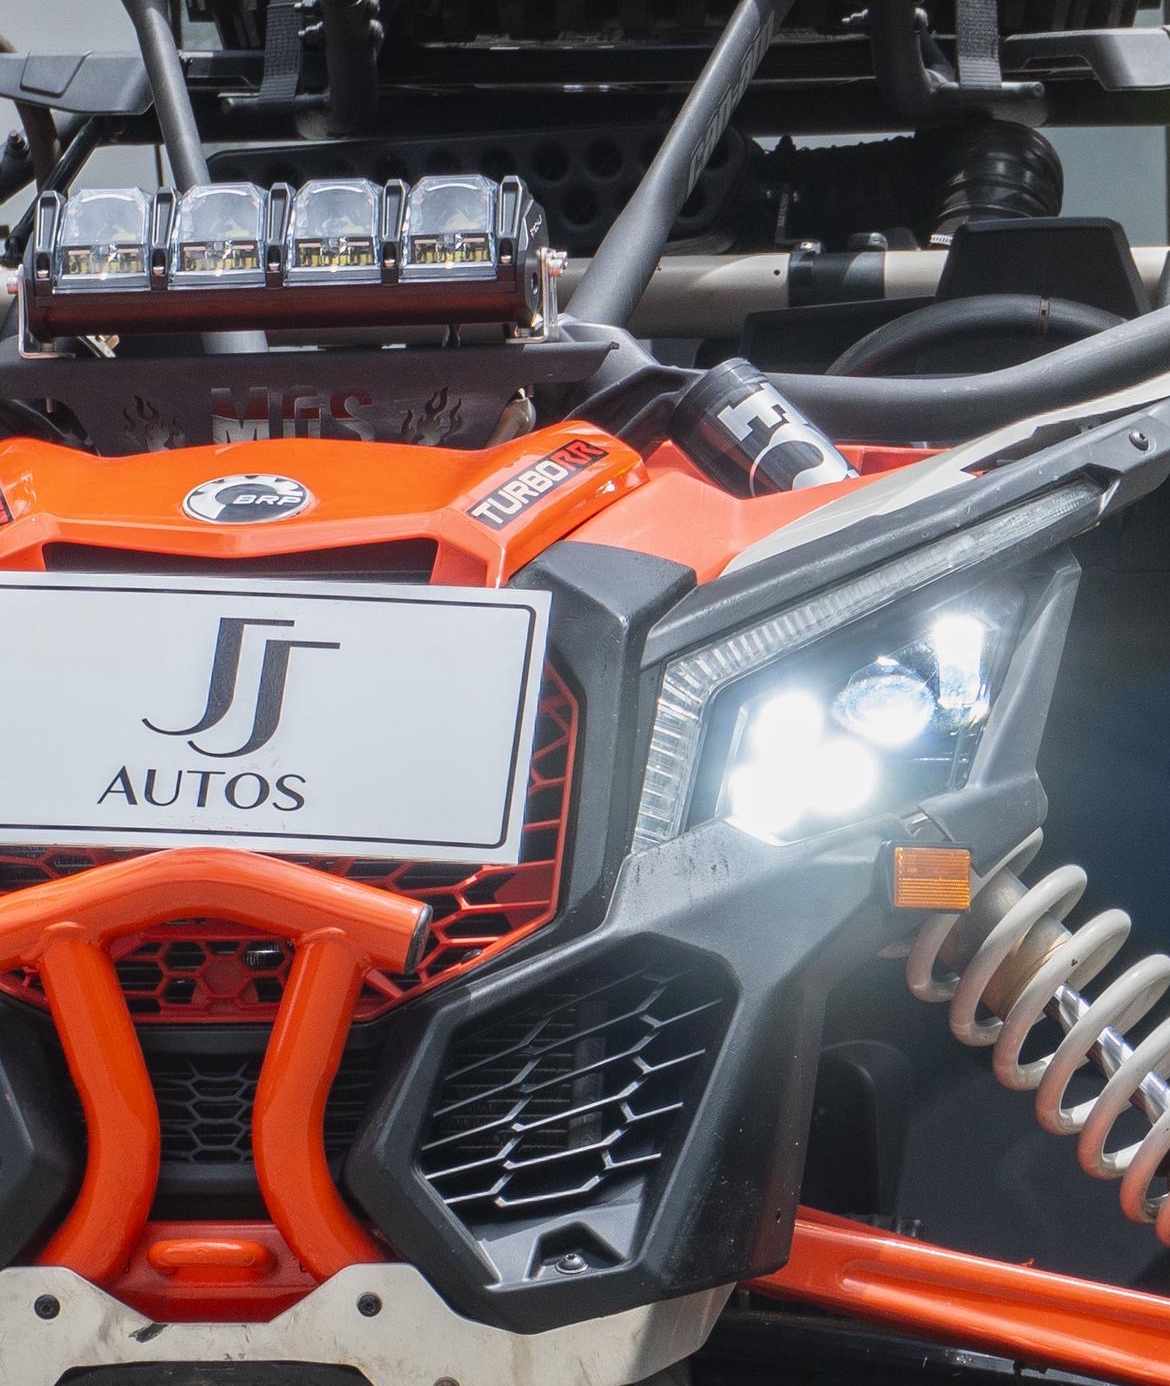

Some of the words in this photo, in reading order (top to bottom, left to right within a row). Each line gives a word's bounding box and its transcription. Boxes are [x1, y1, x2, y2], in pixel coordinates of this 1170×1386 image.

[211, 387, 375, 445] MGS
[233, 494, 301, 506] BRP
[142, 617, 340, 758] JJ
[97, 765, 306, 811] AUTOS
